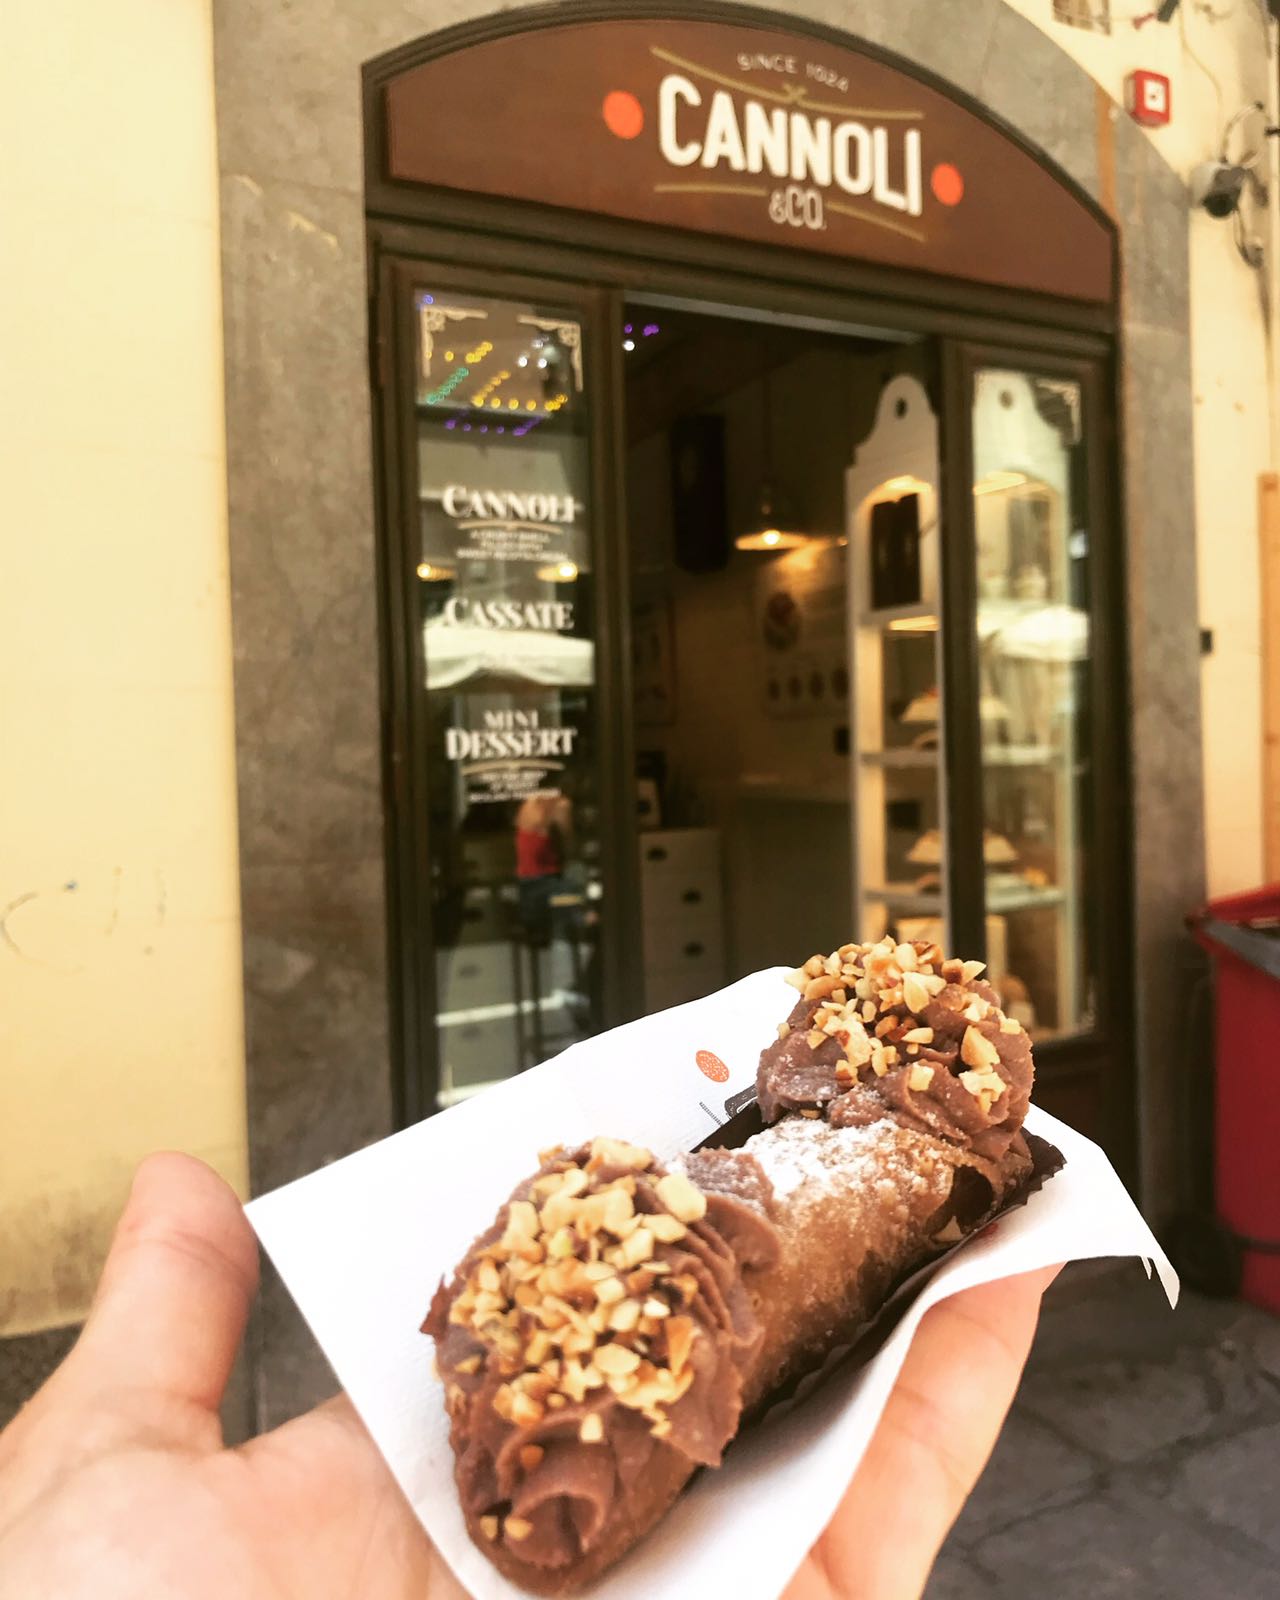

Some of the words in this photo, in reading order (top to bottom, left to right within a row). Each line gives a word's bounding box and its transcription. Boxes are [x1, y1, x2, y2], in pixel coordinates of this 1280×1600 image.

[737, 54, 798, 74] SINCE
[659, 74, 921, 216] CANNOLI
[442, 485, 575, 523] CANNOLI
[443, 598, 574, 629] CASSATE
[484, 710, 538, 729] MINI
[446, 727, 577, 760] DESSERT
